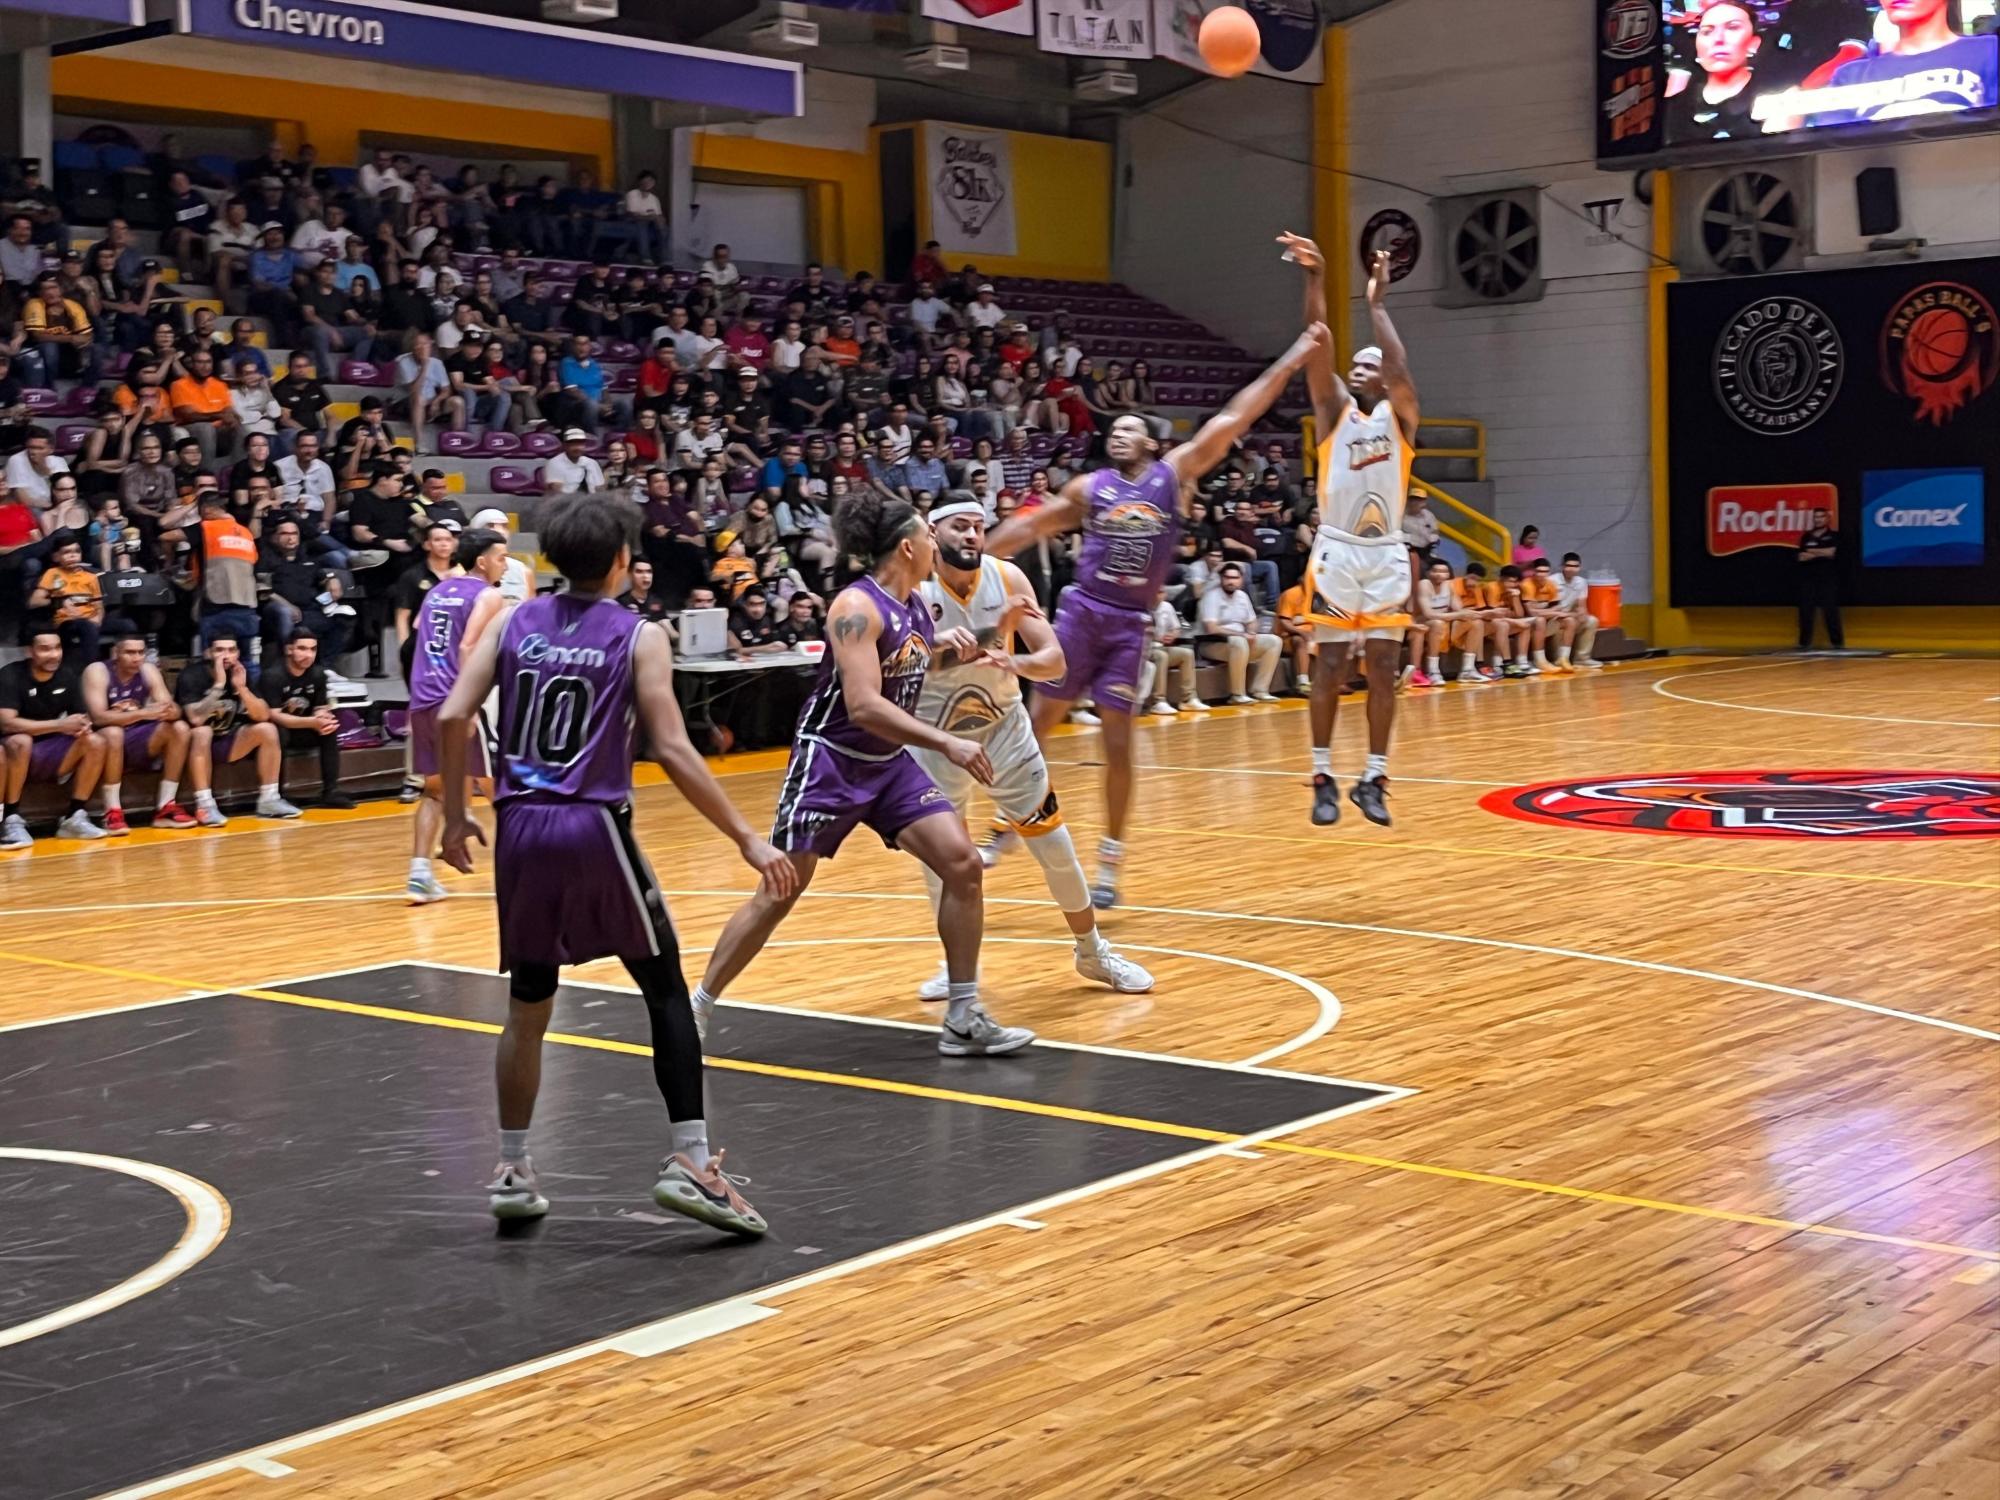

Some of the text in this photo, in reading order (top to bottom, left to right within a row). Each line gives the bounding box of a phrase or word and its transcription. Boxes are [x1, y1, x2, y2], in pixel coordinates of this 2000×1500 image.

[234, 0, 385, 46] Chevron
[1047, 12, 1144, 44] TITAN
[1785, 303, 1819, 330] DE
[1874, 503, 1969, 527] Comex
[504, 668, 596, 768] 10
